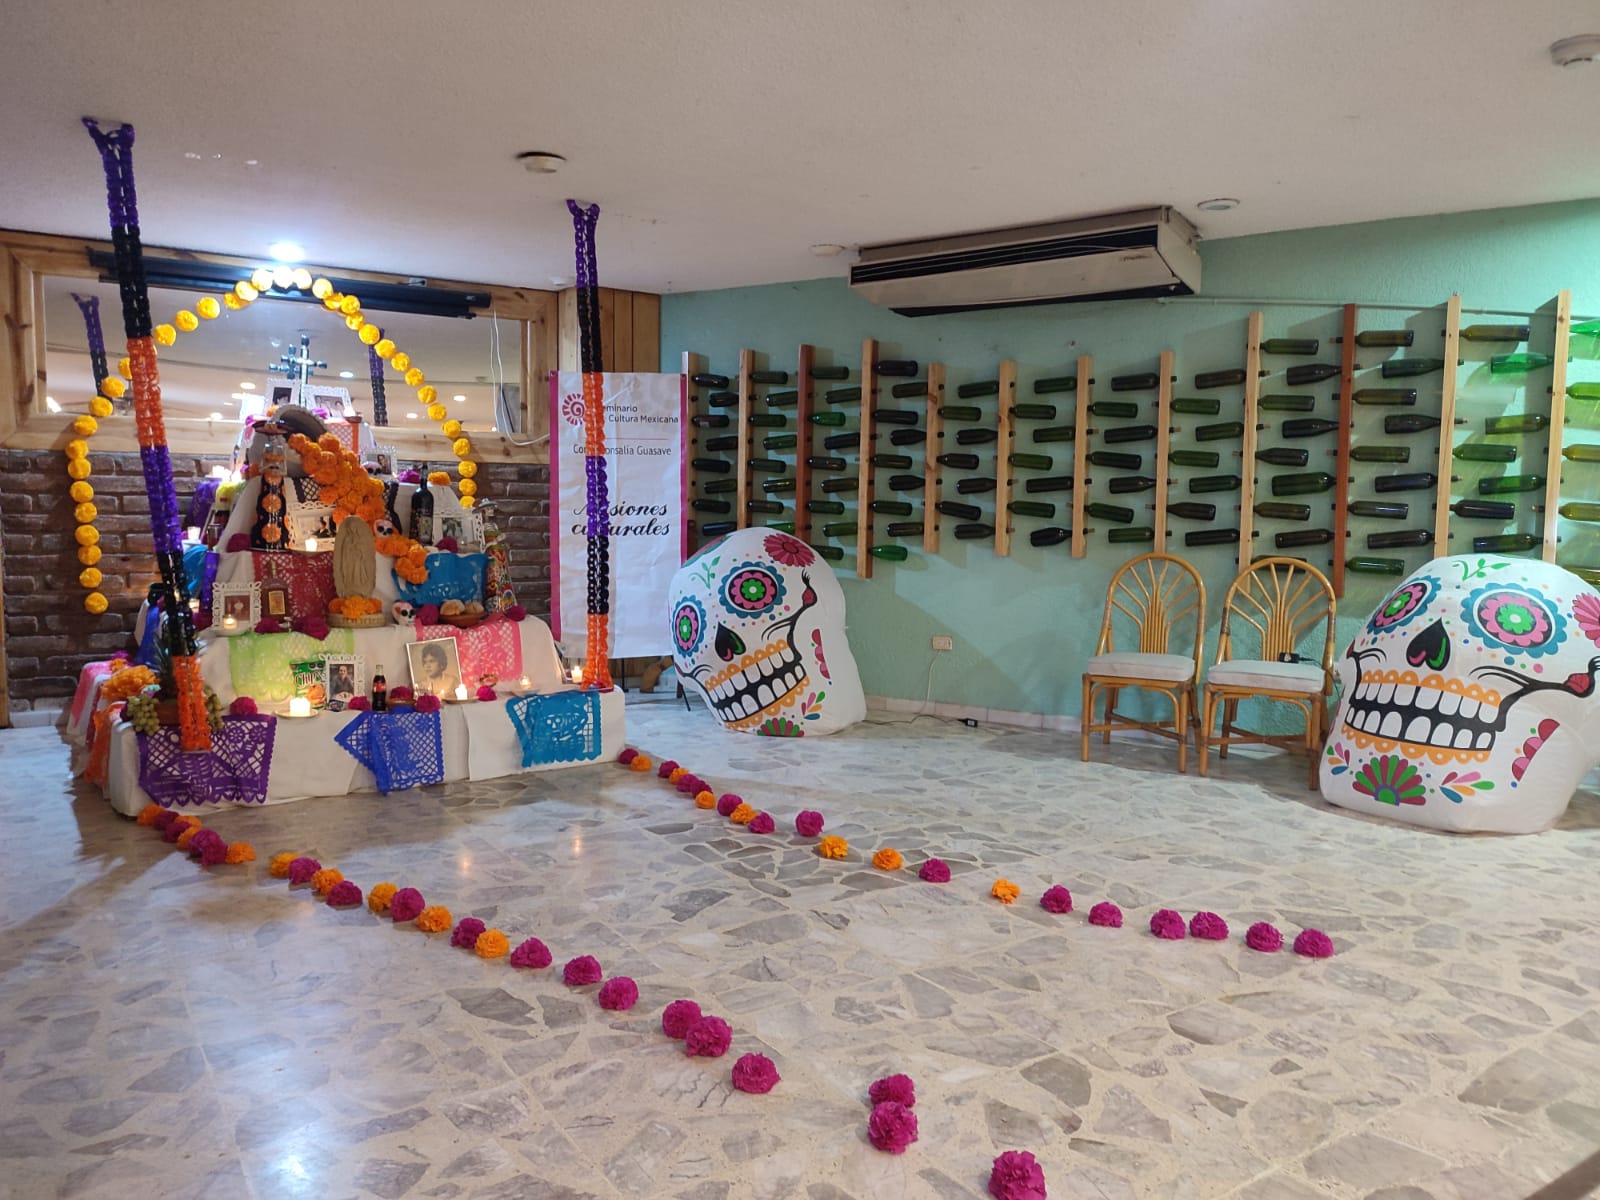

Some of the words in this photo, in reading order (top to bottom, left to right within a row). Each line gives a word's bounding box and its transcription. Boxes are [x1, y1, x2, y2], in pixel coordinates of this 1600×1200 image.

[603, 403, 638, 413] minario
[608, 413, 639, 424] Cultura
[640, 415, 679, 424] Mexicana
[636, 445, 672, 456] Guasave
[573, 500, 668, 517] siones
